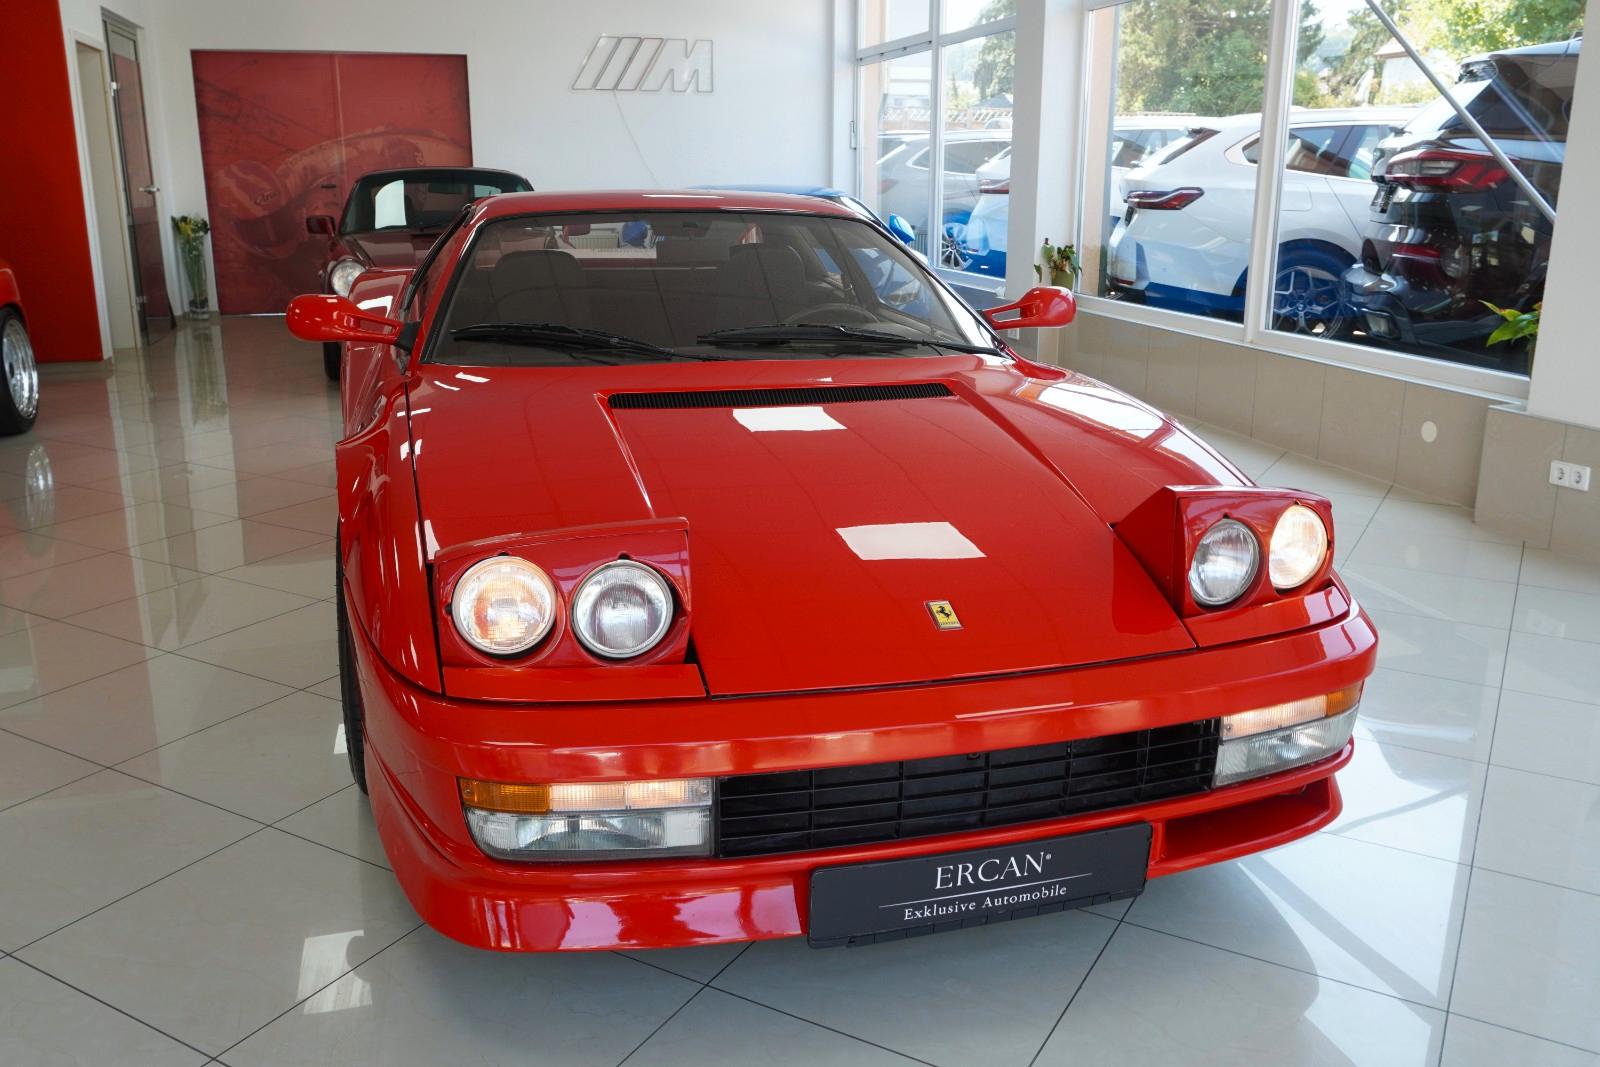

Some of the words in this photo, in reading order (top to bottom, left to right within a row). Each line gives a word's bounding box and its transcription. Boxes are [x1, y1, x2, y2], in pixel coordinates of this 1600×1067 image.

[934, 851, 1045, 890] ERCAN
[903, 902, 977, 921] Exklusive
[981, 884, 1067, 909] Automobile
